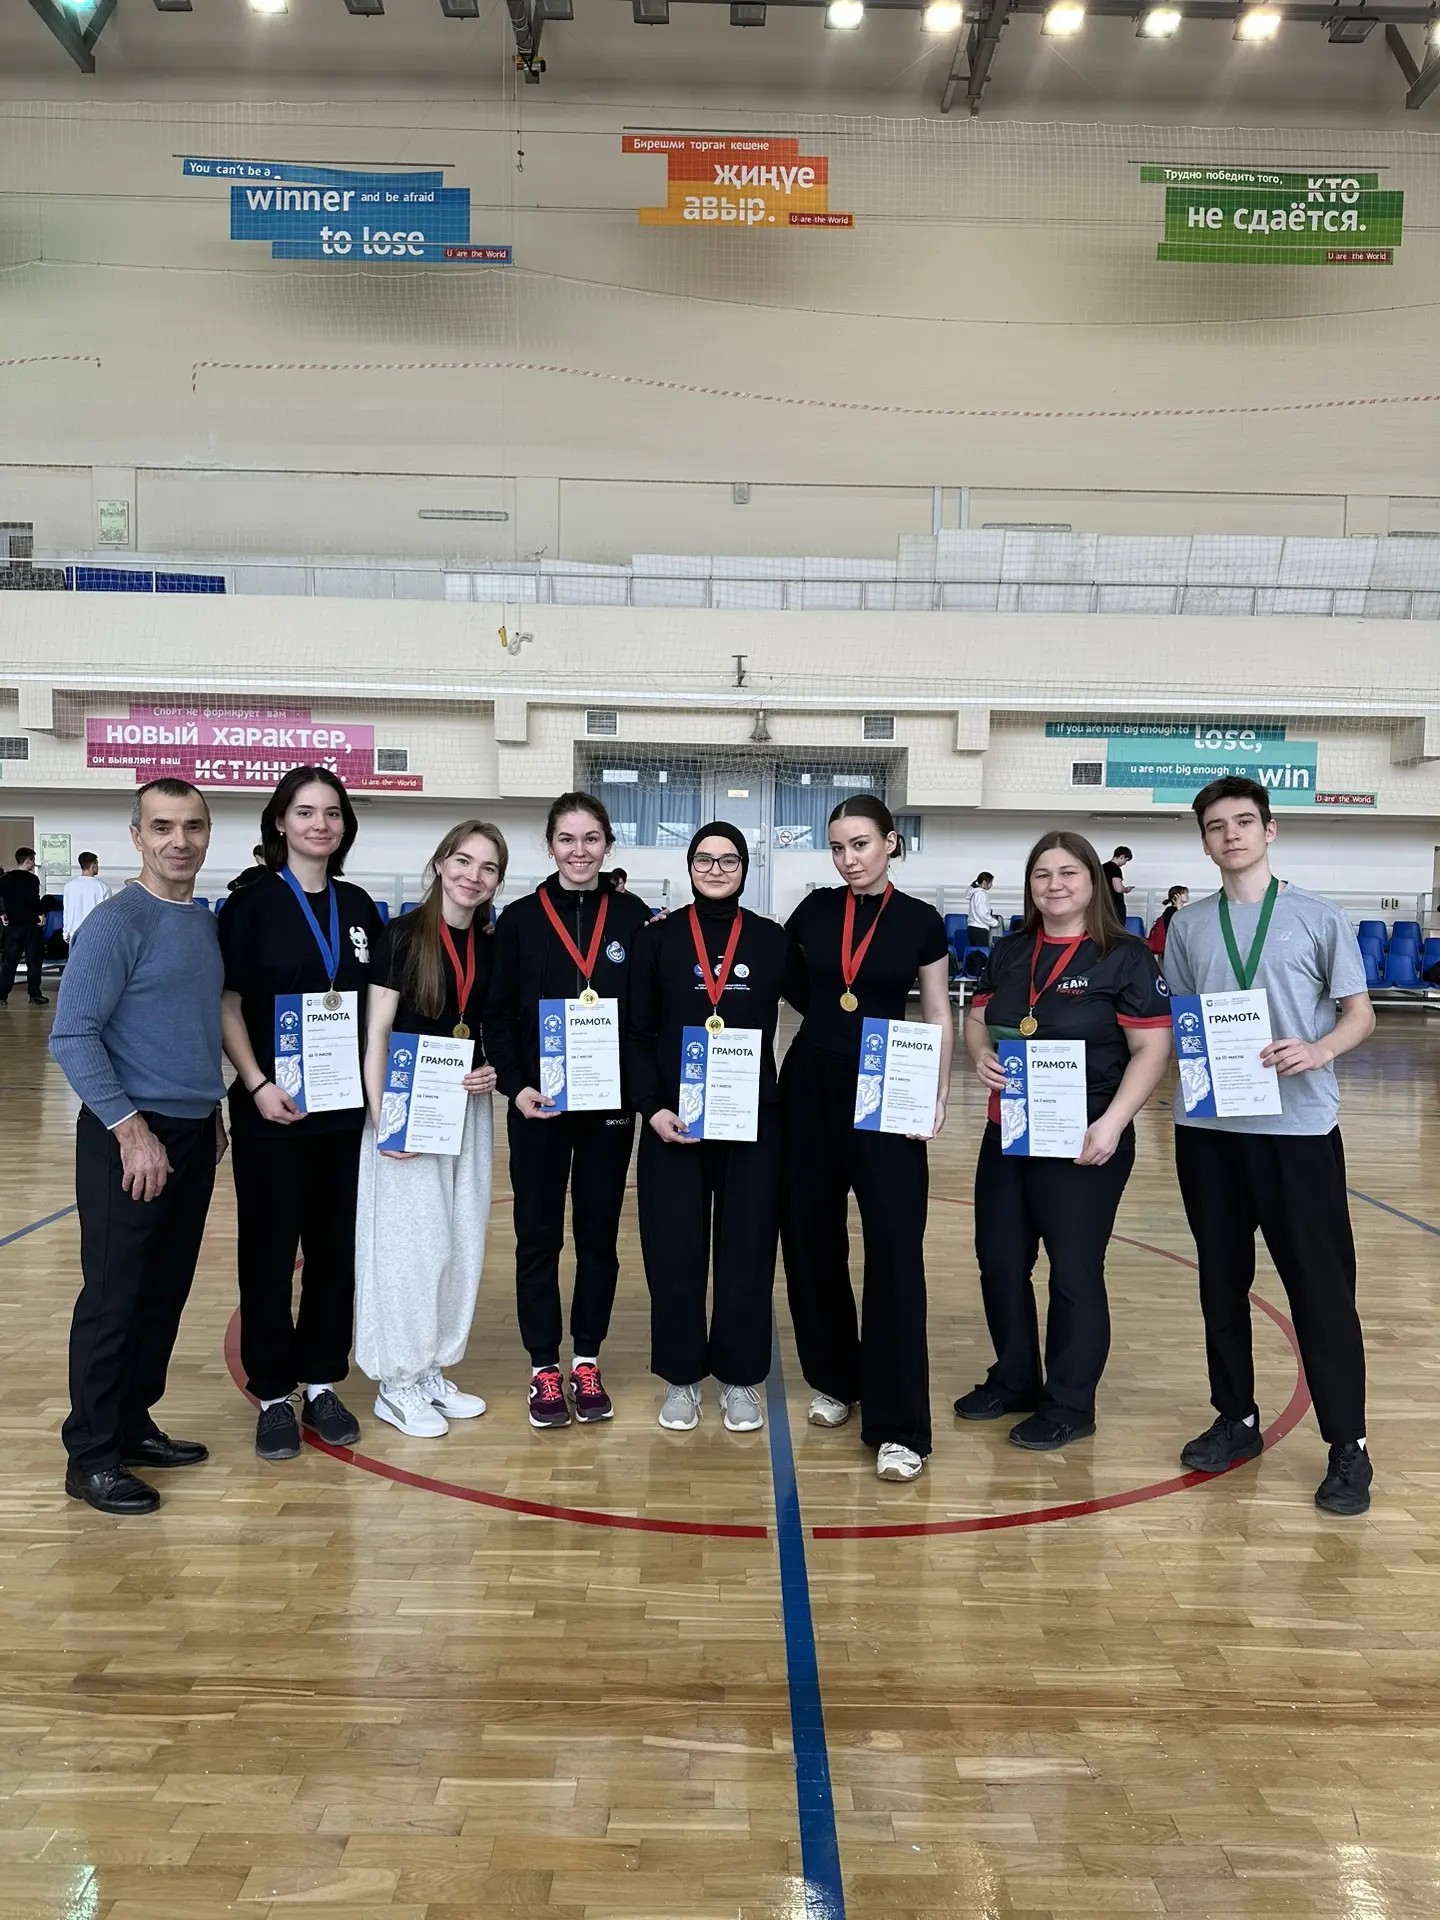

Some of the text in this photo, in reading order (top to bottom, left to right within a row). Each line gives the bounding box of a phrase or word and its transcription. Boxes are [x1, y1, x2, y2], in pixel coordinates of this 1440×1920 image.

[634, 138, 769, 152] Бирешми торган кешене
[189, 162, 210, 173] You
[248, 166, 262, 176] be
[1164, 169, 1283, 185] Трудно победить того,
[246, 177, 434, 212] winner and be afraid
[683, 196, 776, 225] авыр.
[791, 215, 797, 223] U
[828, 216, 849, 224] World
[1188, 202, 1367, 235] не сдаётся.
[320, 226, 425, 256] to lose
[446, 249, 453, 257] U
[486, 250, 506, 258] World
[1352, 252, 1364, 260] the
[1366, 252, 1386, 260] World
[153, 707, 286, 718] Спорт не формирует вам
[1057, 724, 1189, 736] If you are not big enough to
[1194, 727, 1263, 753] lose,
[92, 756, 181, 765] он выявляет ваш
[1156, 765, 1173, 773] not
[1175, 764, 1191, 776] big
[1193, 765, 1229, 776] enough
[1235, 766, 1247, 775] to
[1258, 763, 1310, 788] win
[1317, 794, 1322, 802] U
[307, 1012, 351, 1022] ГРАМОТА
[570, 1017, 612, 1027] ГРАМОТА
[1208, 1012, 1261, 1024] ГРАМОТА
[891, 1039, 934, 1052] ГРАМОТА
[712, 1047, 754, 1057] ГРАМОТА
[420, 1055, 465, 1067] ГРАМОТА
[1031, 1060, 1078, 1069] ГРАМОТА
